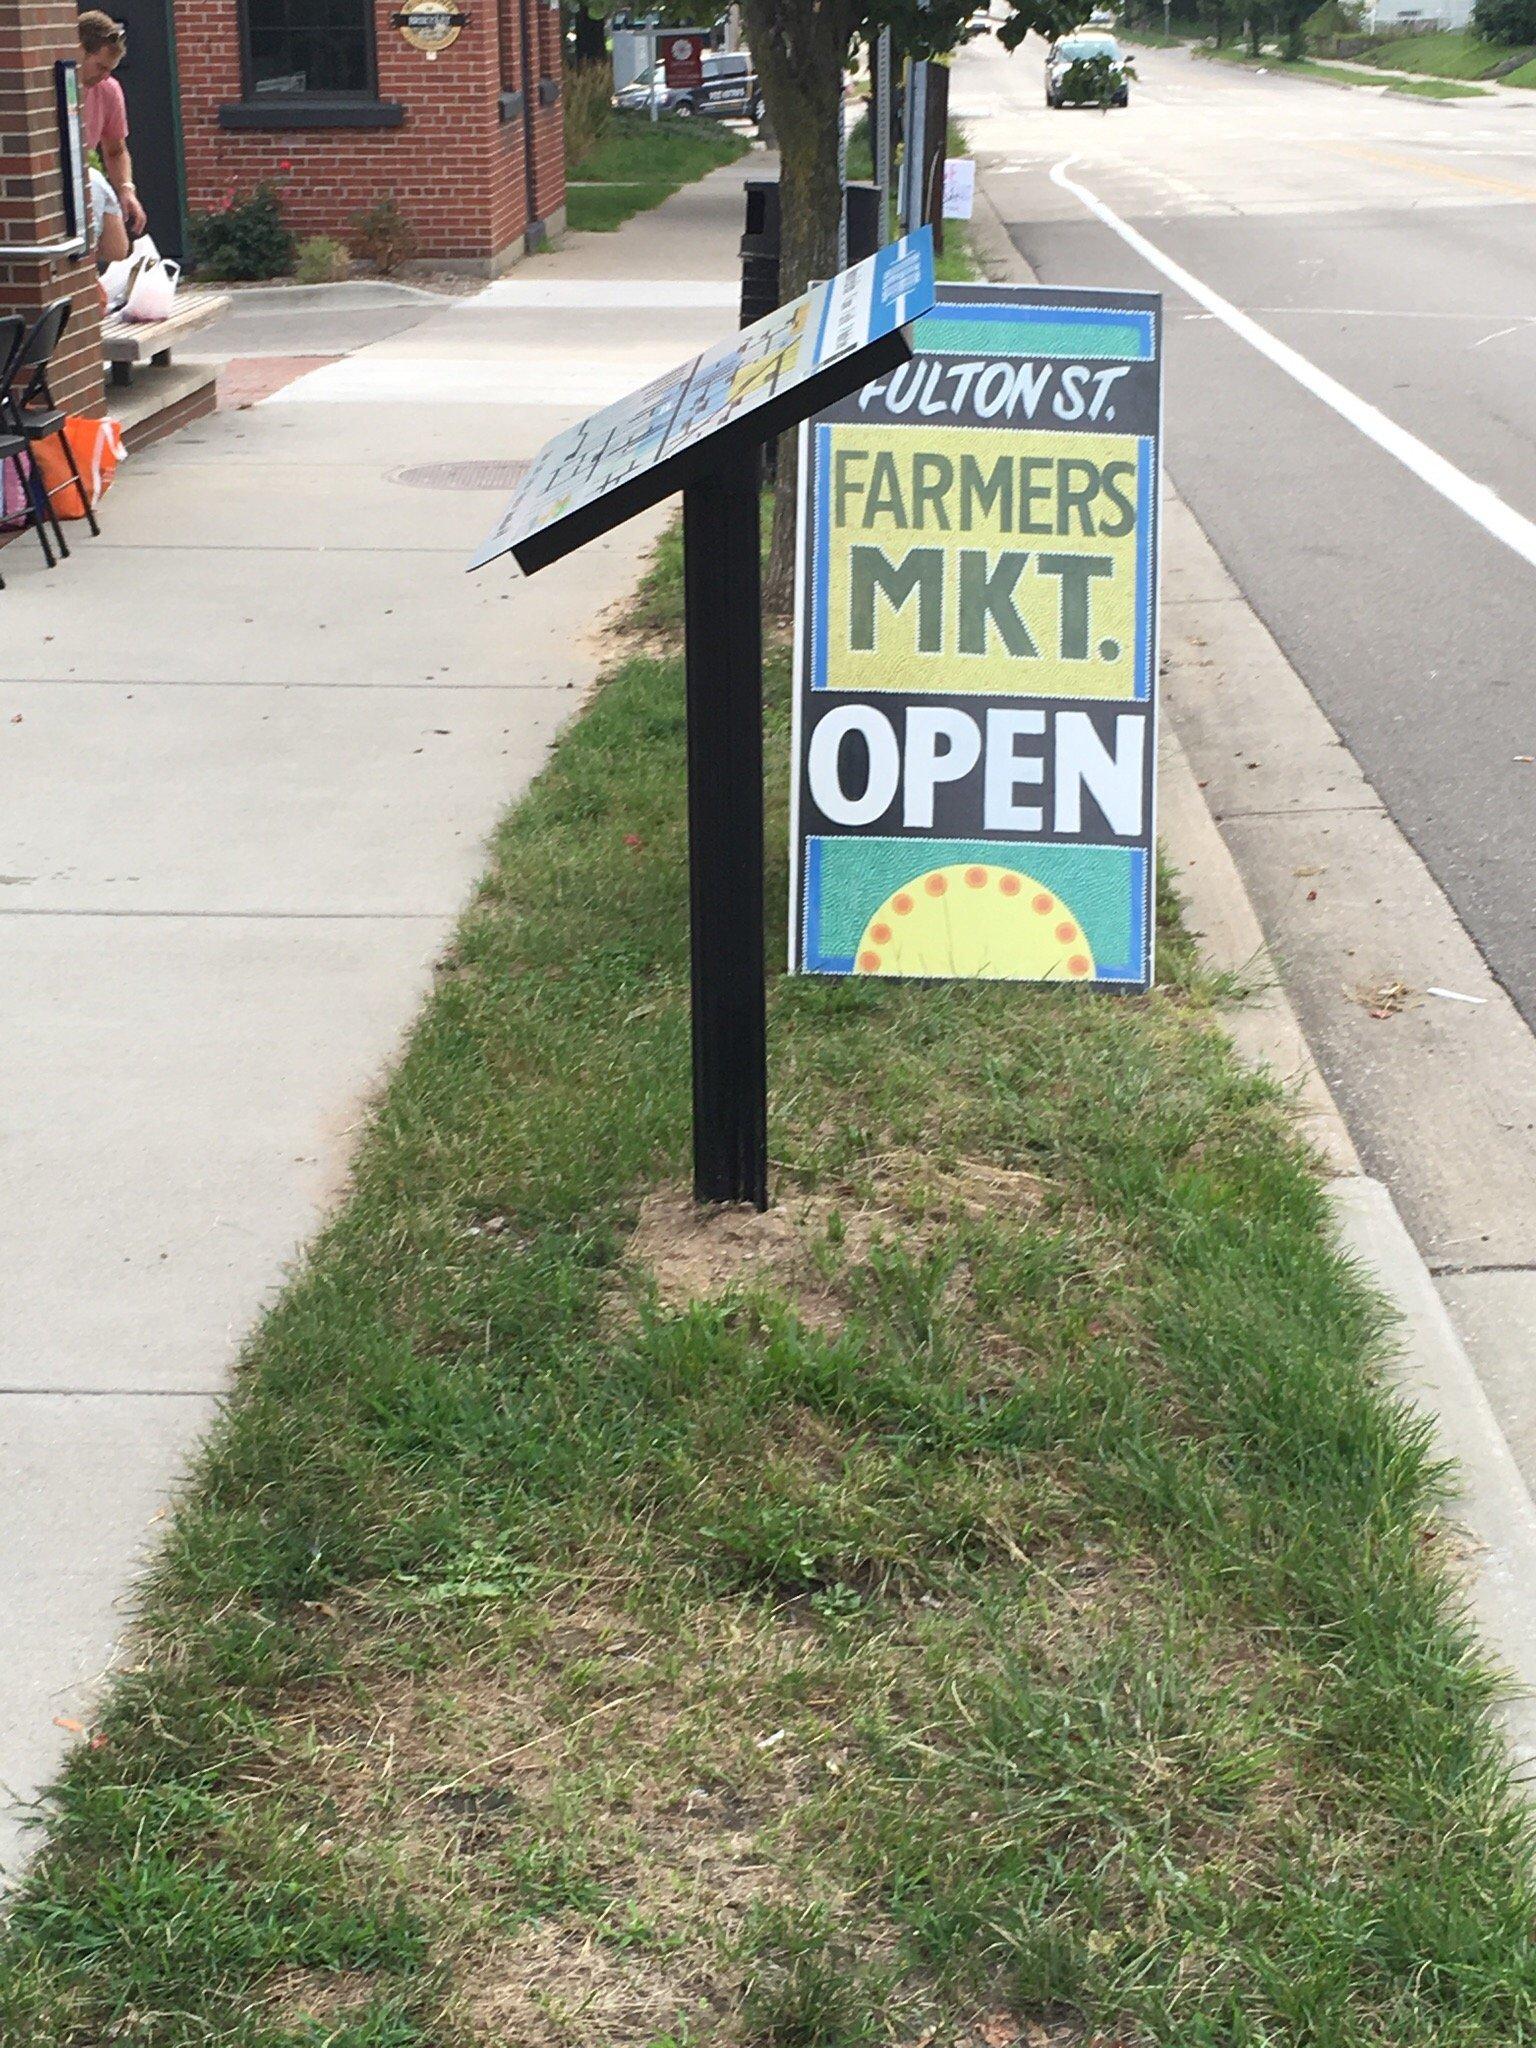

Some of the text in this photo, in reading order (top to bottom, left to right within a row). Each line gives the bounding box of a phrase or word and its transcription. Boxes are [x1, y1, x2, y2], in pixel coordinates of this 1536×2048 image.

[1052, 365, 1131, 422] ST.
[834, 449, 1137, 538] FARMERS
[848, 545, 1121, 663] MKT.
[808, 703, 1145, 837] OPEN
